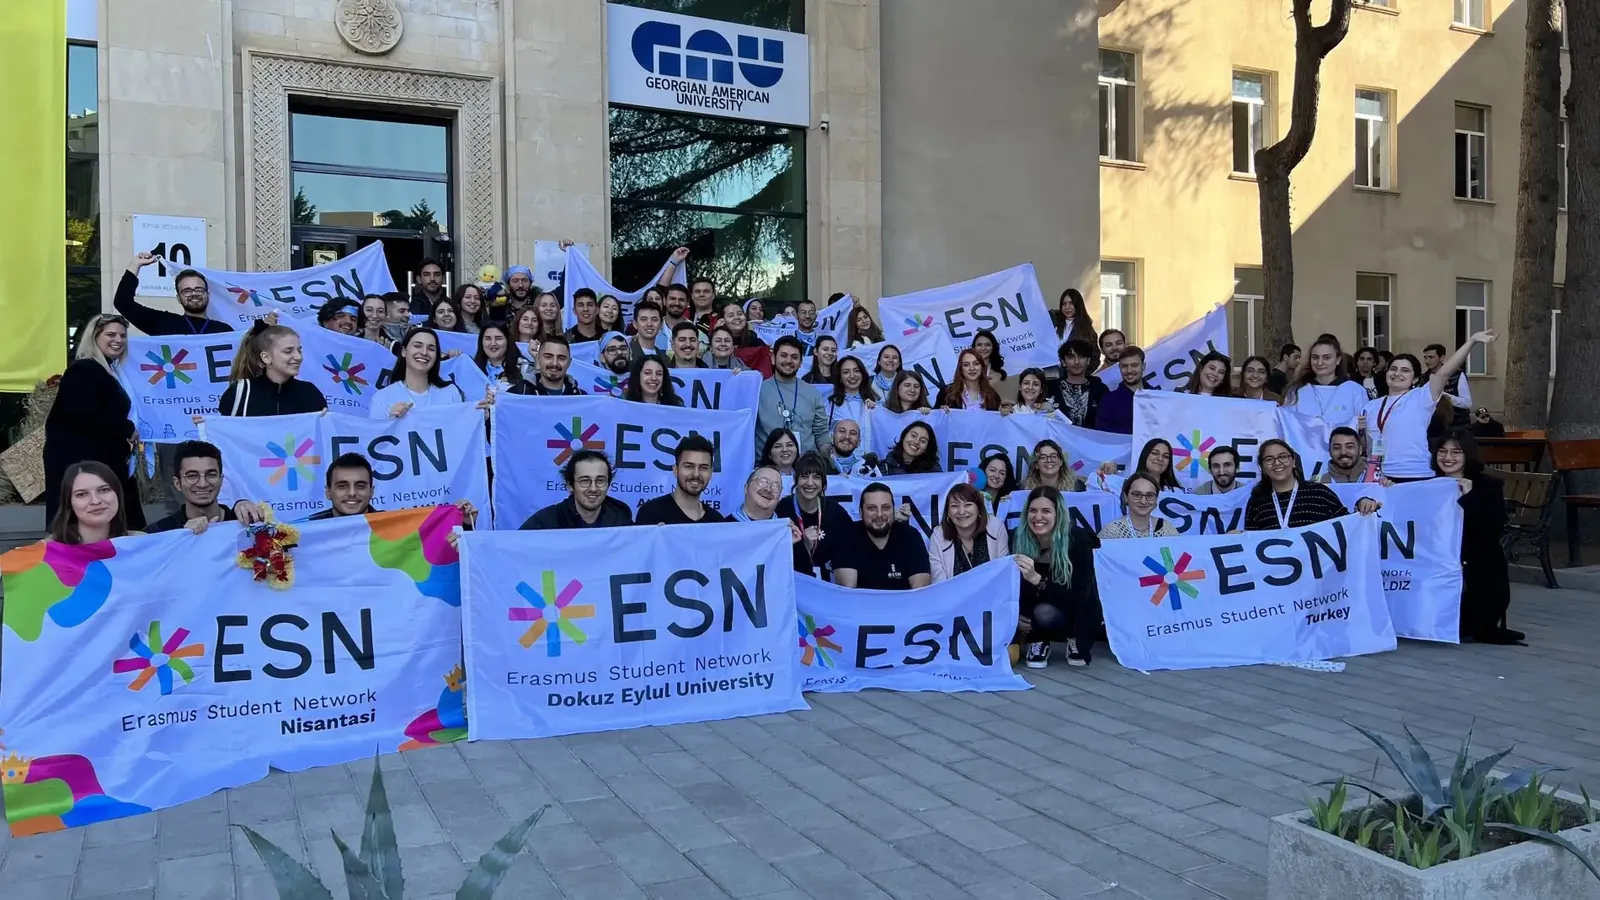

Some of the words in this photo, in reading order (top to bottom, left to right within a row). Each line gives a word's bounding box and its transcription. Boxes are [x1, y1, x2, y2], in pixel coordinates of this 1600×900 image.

[645, 76, 707, 96] GEORGIAN
[712, 86, 770, 104] AMERICAN
[676, 92, 743, 112] UNIVERSITY
[150, 242, 191, 277] 10
[945, 292, 1029, 338] ESN
[998, 331, 1034, 346] etwork
[1010, 341, 1036, 352] Yasar
[143, 396, 200, 405] Erasmus
[262, 500, 324, 511] rasmus
[392, 484, 451, 503] Network
[610, 481, 664, 493] Student
[1158, 496, 1242, 535] SN
[1210, 520, 1348, 595] ESN
[1381, 569, 1413, 578] work
[1383, 580, 1411, 592] LDIZ
[610, 563, 768, 643] ESN
[1146, 616, 1213, 637] Erasmus
[1220, 603, 1286, 625] Student
[1293, 587, 1350, 612] Network
[1305, 605, 1351, 626] Turkey
[213, 607, 376, 683] ESN
[855, 611, 993, 669] ESN
[507, 669, 597, 686] Erasmus
[609, 659, 686, 681] Student
[695, 648, 772, 671] Network
[547, 692, 614, 707] Dokuz
[621, 685, 671, 704] Eylul
[676, 670, 774, 697] University
[121, 708, 198, 732] Erasmus
[207, 699, 282, 720] Student
[293, 688, 377, 711] Network
[281, 708, 376, 735] Nisantasi
